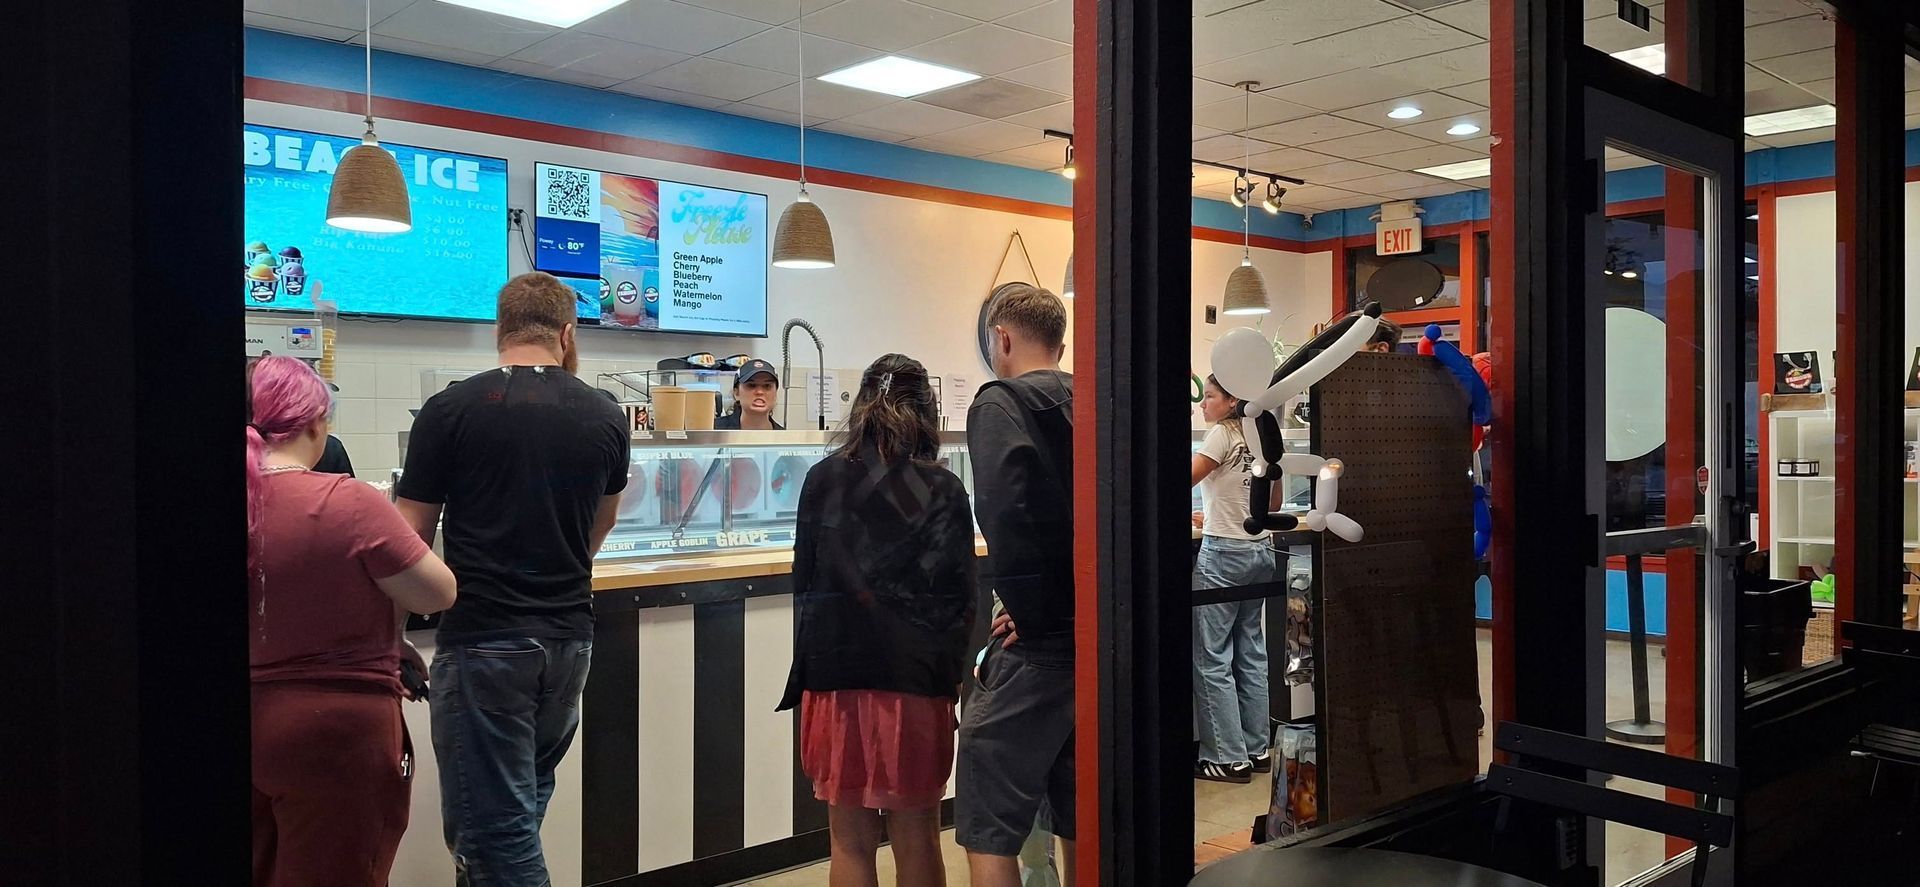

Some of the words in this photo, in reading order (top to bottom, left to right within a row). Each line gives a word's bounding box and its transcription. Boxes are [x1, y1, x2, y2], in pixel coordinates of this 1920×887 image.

[414, 153, 480, 193] ICE
[432, 195, 462, 208] Nut
[467, 200, 498, 212] Free
[1384, 228, 1412, 253] EXIT
[673, 251, 698, 262] Green
[700, 254, 723, 265] Apple
[673, 261, 700, 273] Cherry
[673, 270, 713, 283] Blueberry
[673, 280, 699, 290] Peach
[673, 289, 723, 301] Watermelon
[673, 298, 702, 310] Mango
[672, 450, 695, 459] BLUE
[650, 539, 678, 549] APPLE
[678, 537, 709, 548] GOBLIN
[715, 529, 769, 548] GRAPE
[600, 541, 636, 553] CHERRY
